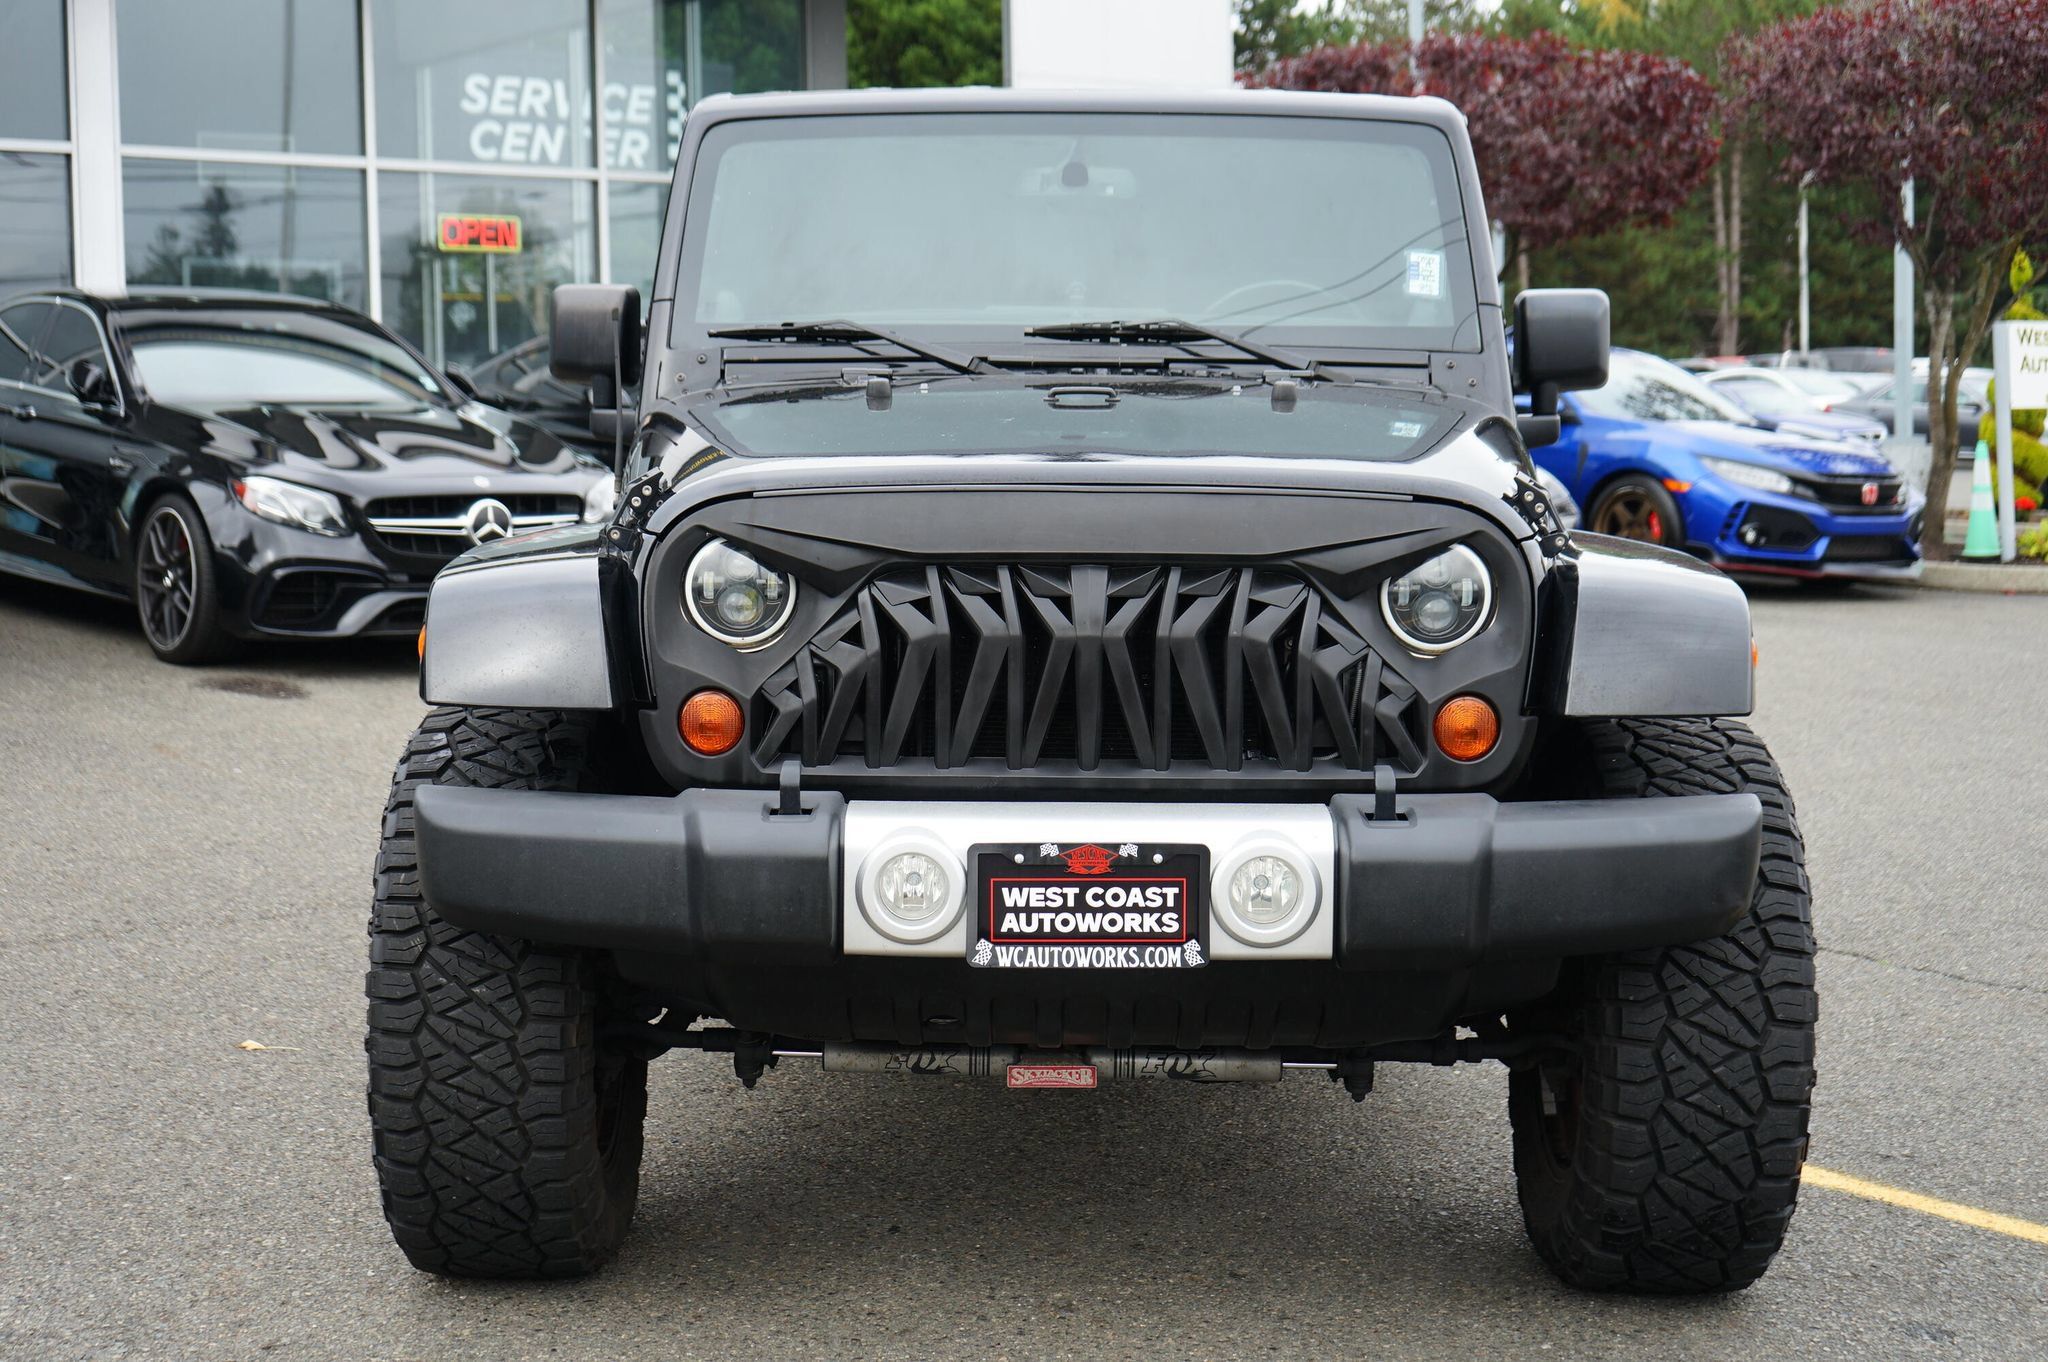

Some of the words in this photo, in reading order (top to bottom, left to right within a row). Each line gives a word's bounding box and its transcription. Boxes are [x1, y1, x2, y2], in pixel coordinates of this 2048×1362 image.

[469, 118, 650, 168] CENER
[442, 216, 518, 248] OPEN
[1001, 886, 1080, 908] WEST
[1085, 886, 1180, 908] COAST
[1000, 912, 1180, 933] AUTOWORKS
[995, 945, 1182, 968] WCAUTOWORKS.COM
[1141, 1051, 1217, 1076] FOX
[1010, 1067, 1094, 1085] SKYJACKER
